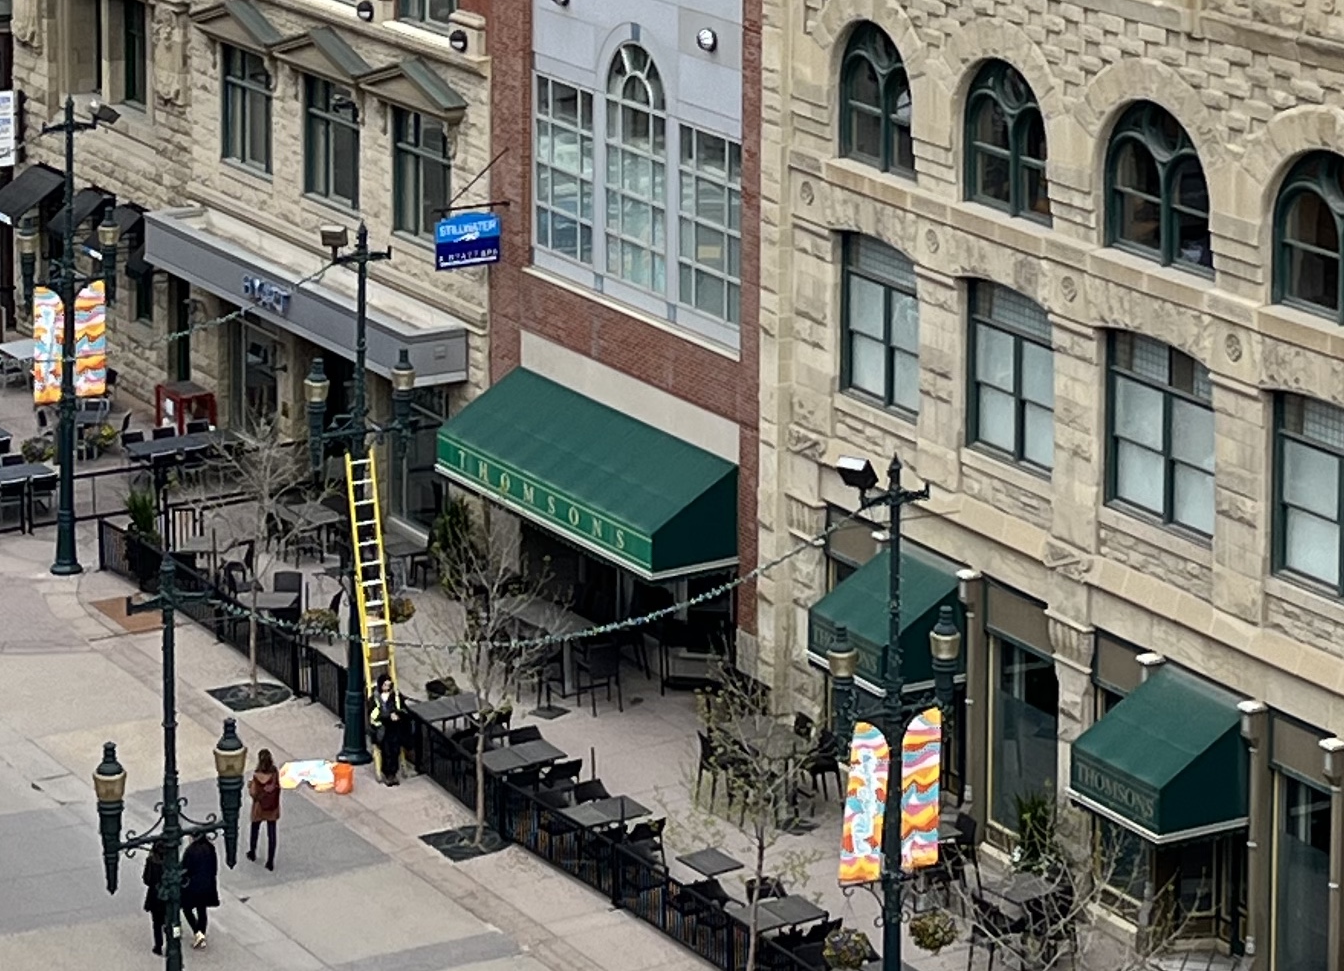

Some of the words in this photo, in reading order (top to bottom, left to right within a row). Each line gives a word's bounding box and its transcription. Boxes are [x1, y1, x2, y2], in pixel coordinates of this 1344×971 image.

[439, 218, 497, 238] STILLWATER
[458, 449, 626, 549] THOMSONS
[1076, 760, 1154, 818] THOMSONS
